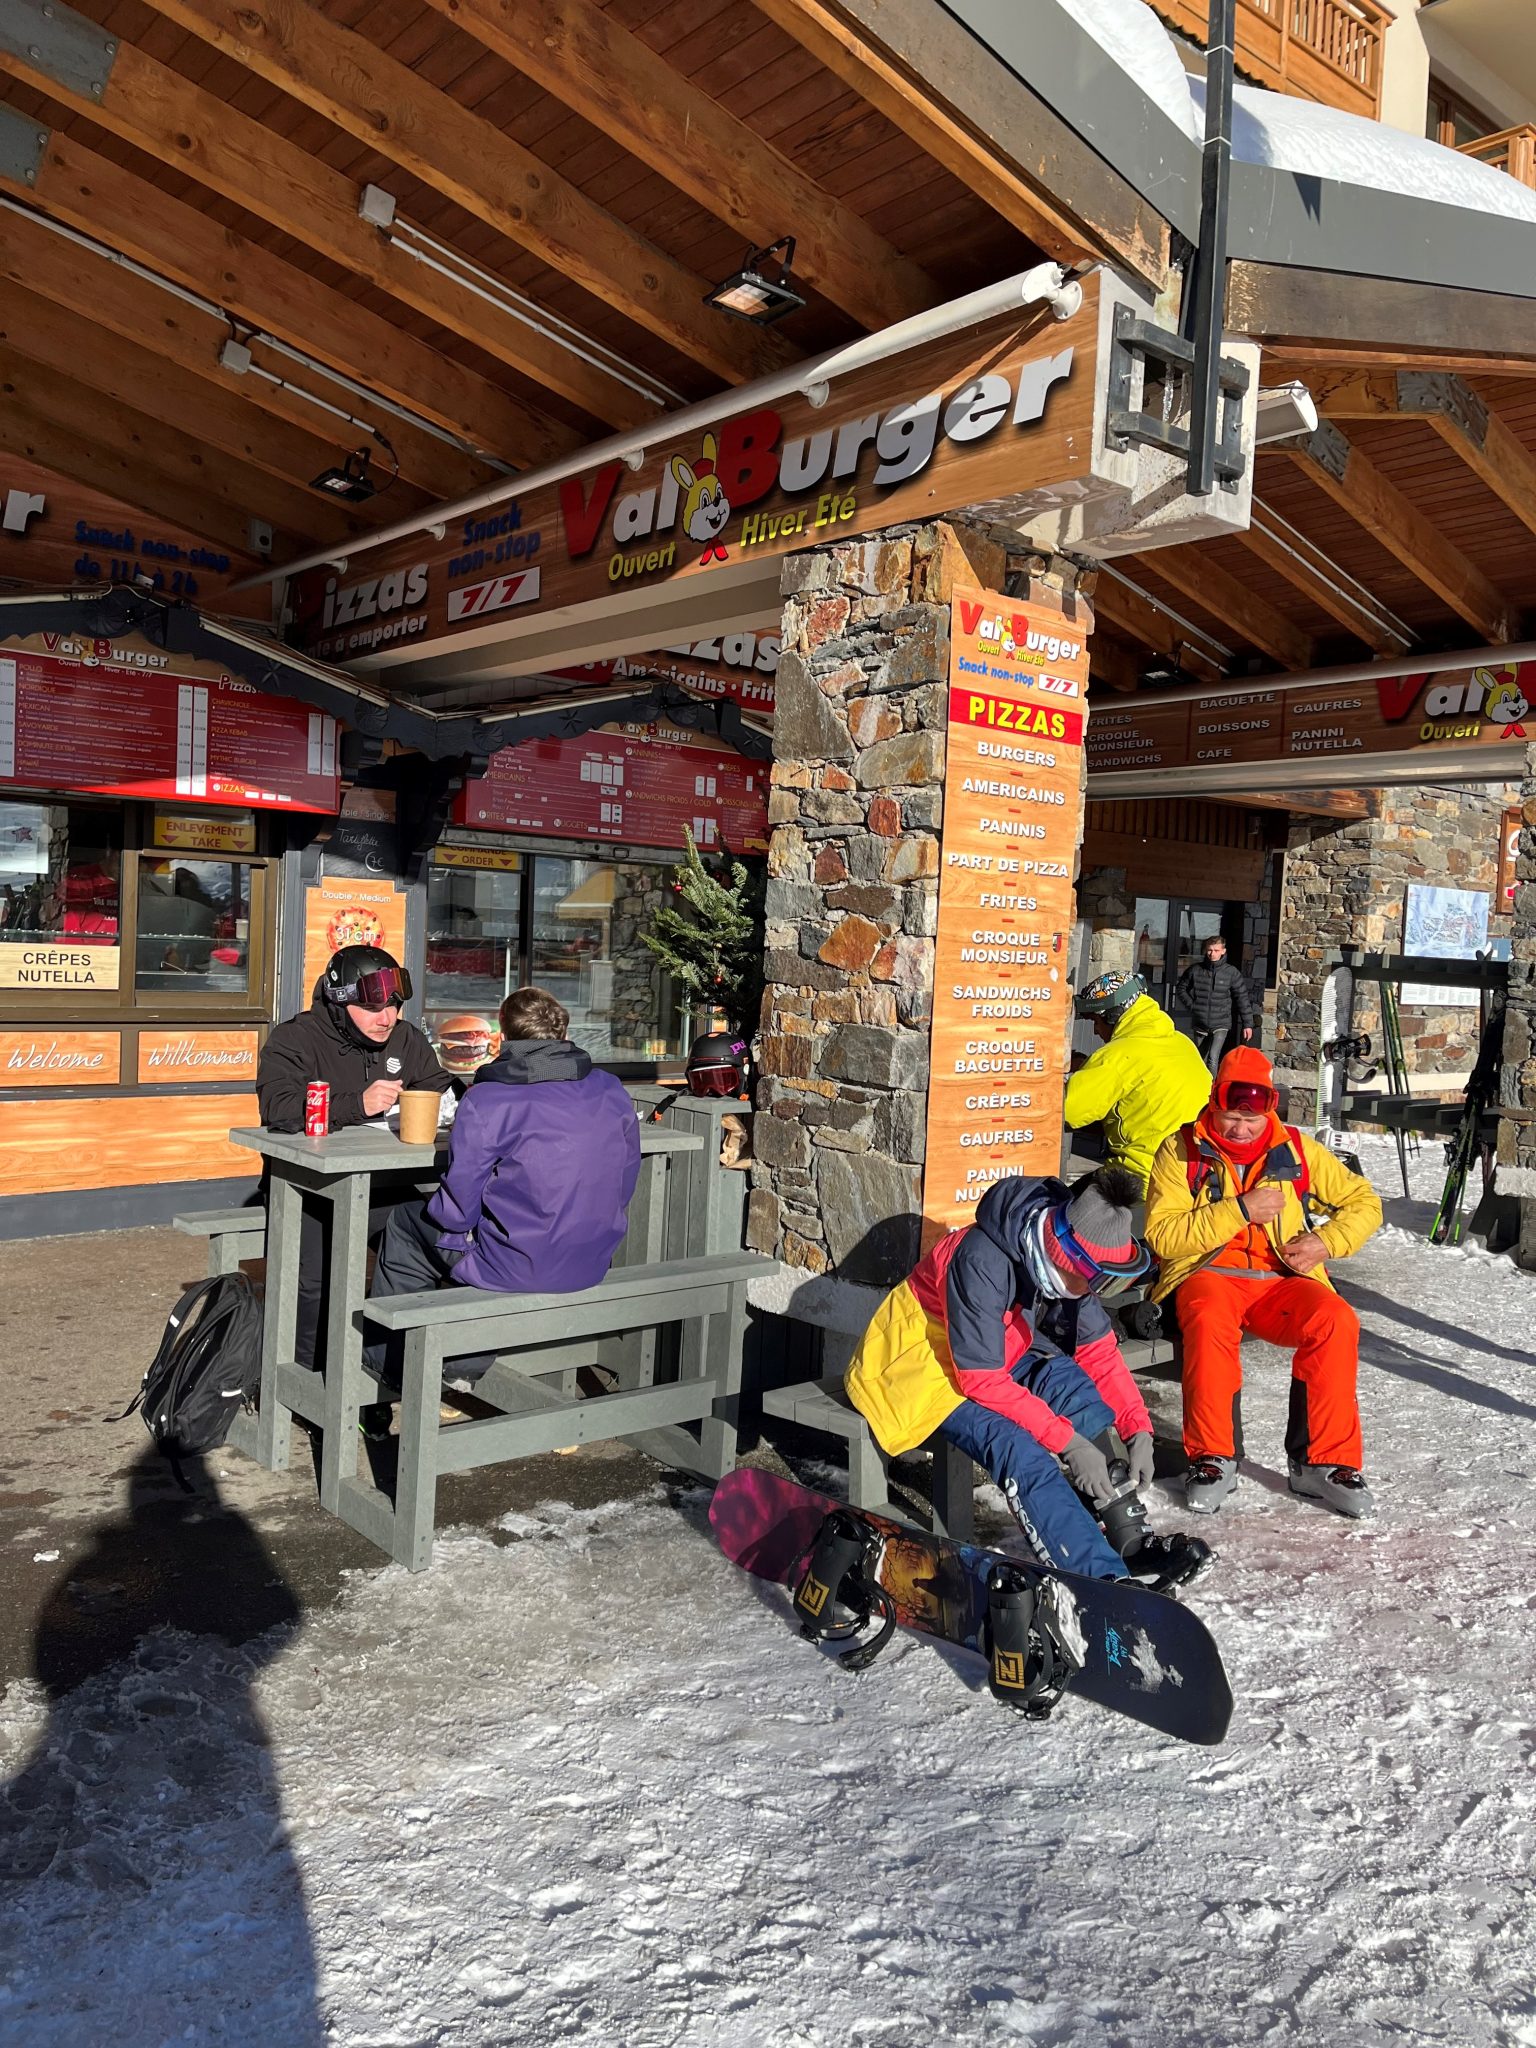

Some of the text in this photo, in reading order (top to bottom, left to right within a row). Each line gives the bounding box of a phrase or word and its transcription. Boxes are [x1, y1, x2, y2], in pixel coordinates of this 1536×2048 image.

[560, 346, 1075, 557] Val Burger
[463, 500, 522, 546] Snack
[608, 485, 856, 581] Ouvert Hiver Eté
[75, 520, 231, 573] Snack non-stop
[448, 531, 541, 579] non-stop
[75, 553, 101, 576] de
[172, 570, 197, 595] 2h
[461, 574, 527, 614] 7/7
[349, 615, 428, 648] emporter
[960, 600, 1081, 661] Val Burger
[93, 639, 168, 668] Burger
[978, 640, 1000, 656] Ouvert
[1016, 650, 1034, 664] Hiver
[58, 659, 81, 669] Ouvert
[219, 673, 257, 694] Pizzas
[958, 656, 1074, 693] Snack non-stop 7/7
[741, 680, 776, 702] Frit
[1376, 669, 1486, 721] Val
[1200, 692, 1275, 709] BAGUETTE
[1293, 699, 1362, 714] GAUFRES
[969, 695, 1066, 738] PIZZAS
[1089, 714, 1133, 727] FRITES
[648, 720, 693, 742] Burger
[1198, 719, 1270, 734] BOISSONS
[1291, 727, 1344, 740] PANINI
[1419, 721, 1481, 741] Ouvert
[1088, 730, 1140, 743] CROQUE
[1088, 738, 1154, 752] MONSIEUR
[1291, 737, 1362, 751] NUTELLA
[977, 741, 1057, 767] BURGERS
[1087, 754, 1162, 768] SANDWICHS
[1197, 748, 1232, 760] CAFE
[962, 777, 1066, 806] AMERICAINS
[166, 821, 244, 836] ENLEVEMENT
[979, 818, 1046, 839] PANINIS
[191, 837, 221, 848] TAKE
[462, 855, 494, 866] ORDER
[948, 852, 1069, 878] PART DE PIZZA
[322, 890, 352, 900] Double
[359, 893, 391, 903] Medium
[979, 893, 1038, 911] FRITES
[971, 930, 1041, 947] CROQUE
[23, 950, 91, 966] CRÊPES
[960, 948, 1048, 965] MONSIEUR
[18, 970, 95, 983] NUTELLA
[952, 985, 1051, 1001] SANDWICHS
[971, 1004, 1033, 1019] FROIDS
[8, 1041, 103, 1068] Welcome
[148, 1039, 253, 1066] Willkommen
[965, 1040, 1035, 1055] CROQUE
[954, 1058, 1044, 1073] BAGUETTE
[965, 1092, 1031, 1110] CRÊPES
[959, 1129, 1034, 1147] GAUFRES
[966, 1165, 1025, 1183] PANINI
